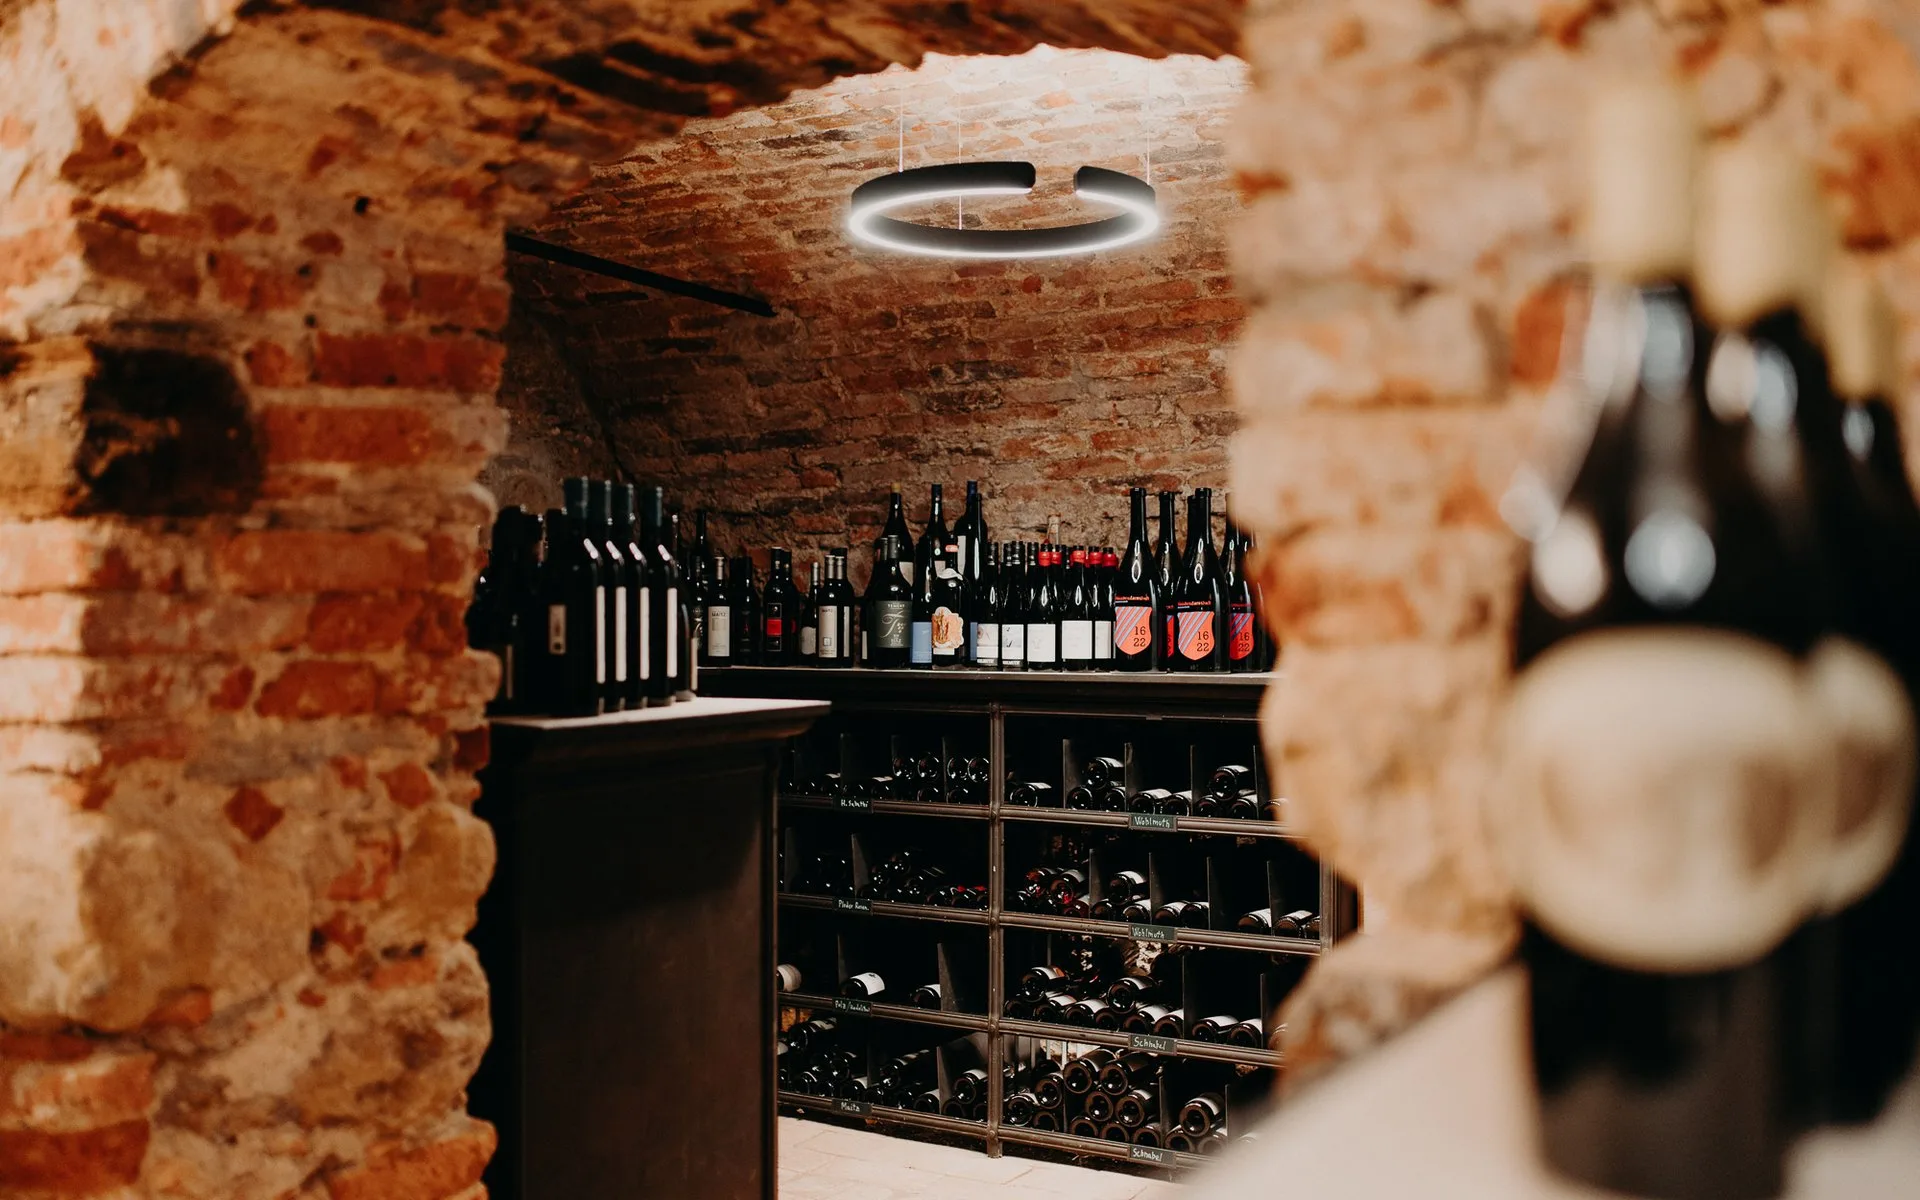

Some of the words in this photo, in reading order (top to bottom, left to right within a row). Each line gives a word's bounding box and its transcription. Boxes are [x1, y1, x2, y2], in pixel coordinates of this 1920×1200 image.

[1134, 626, 1146, 636] 16
[1197, 631, 1210, 640] 16
[1239, 632, 1250, 641] 16
[1133, 638, 1146, 647] 22
[1196, 643, 1210, 652] 22
[1238, 643, 1250, 652] 22
[1133, 1036, 1167, 1050] Schnabel
[1132, 1147, 1163, 1161] Schnabel
